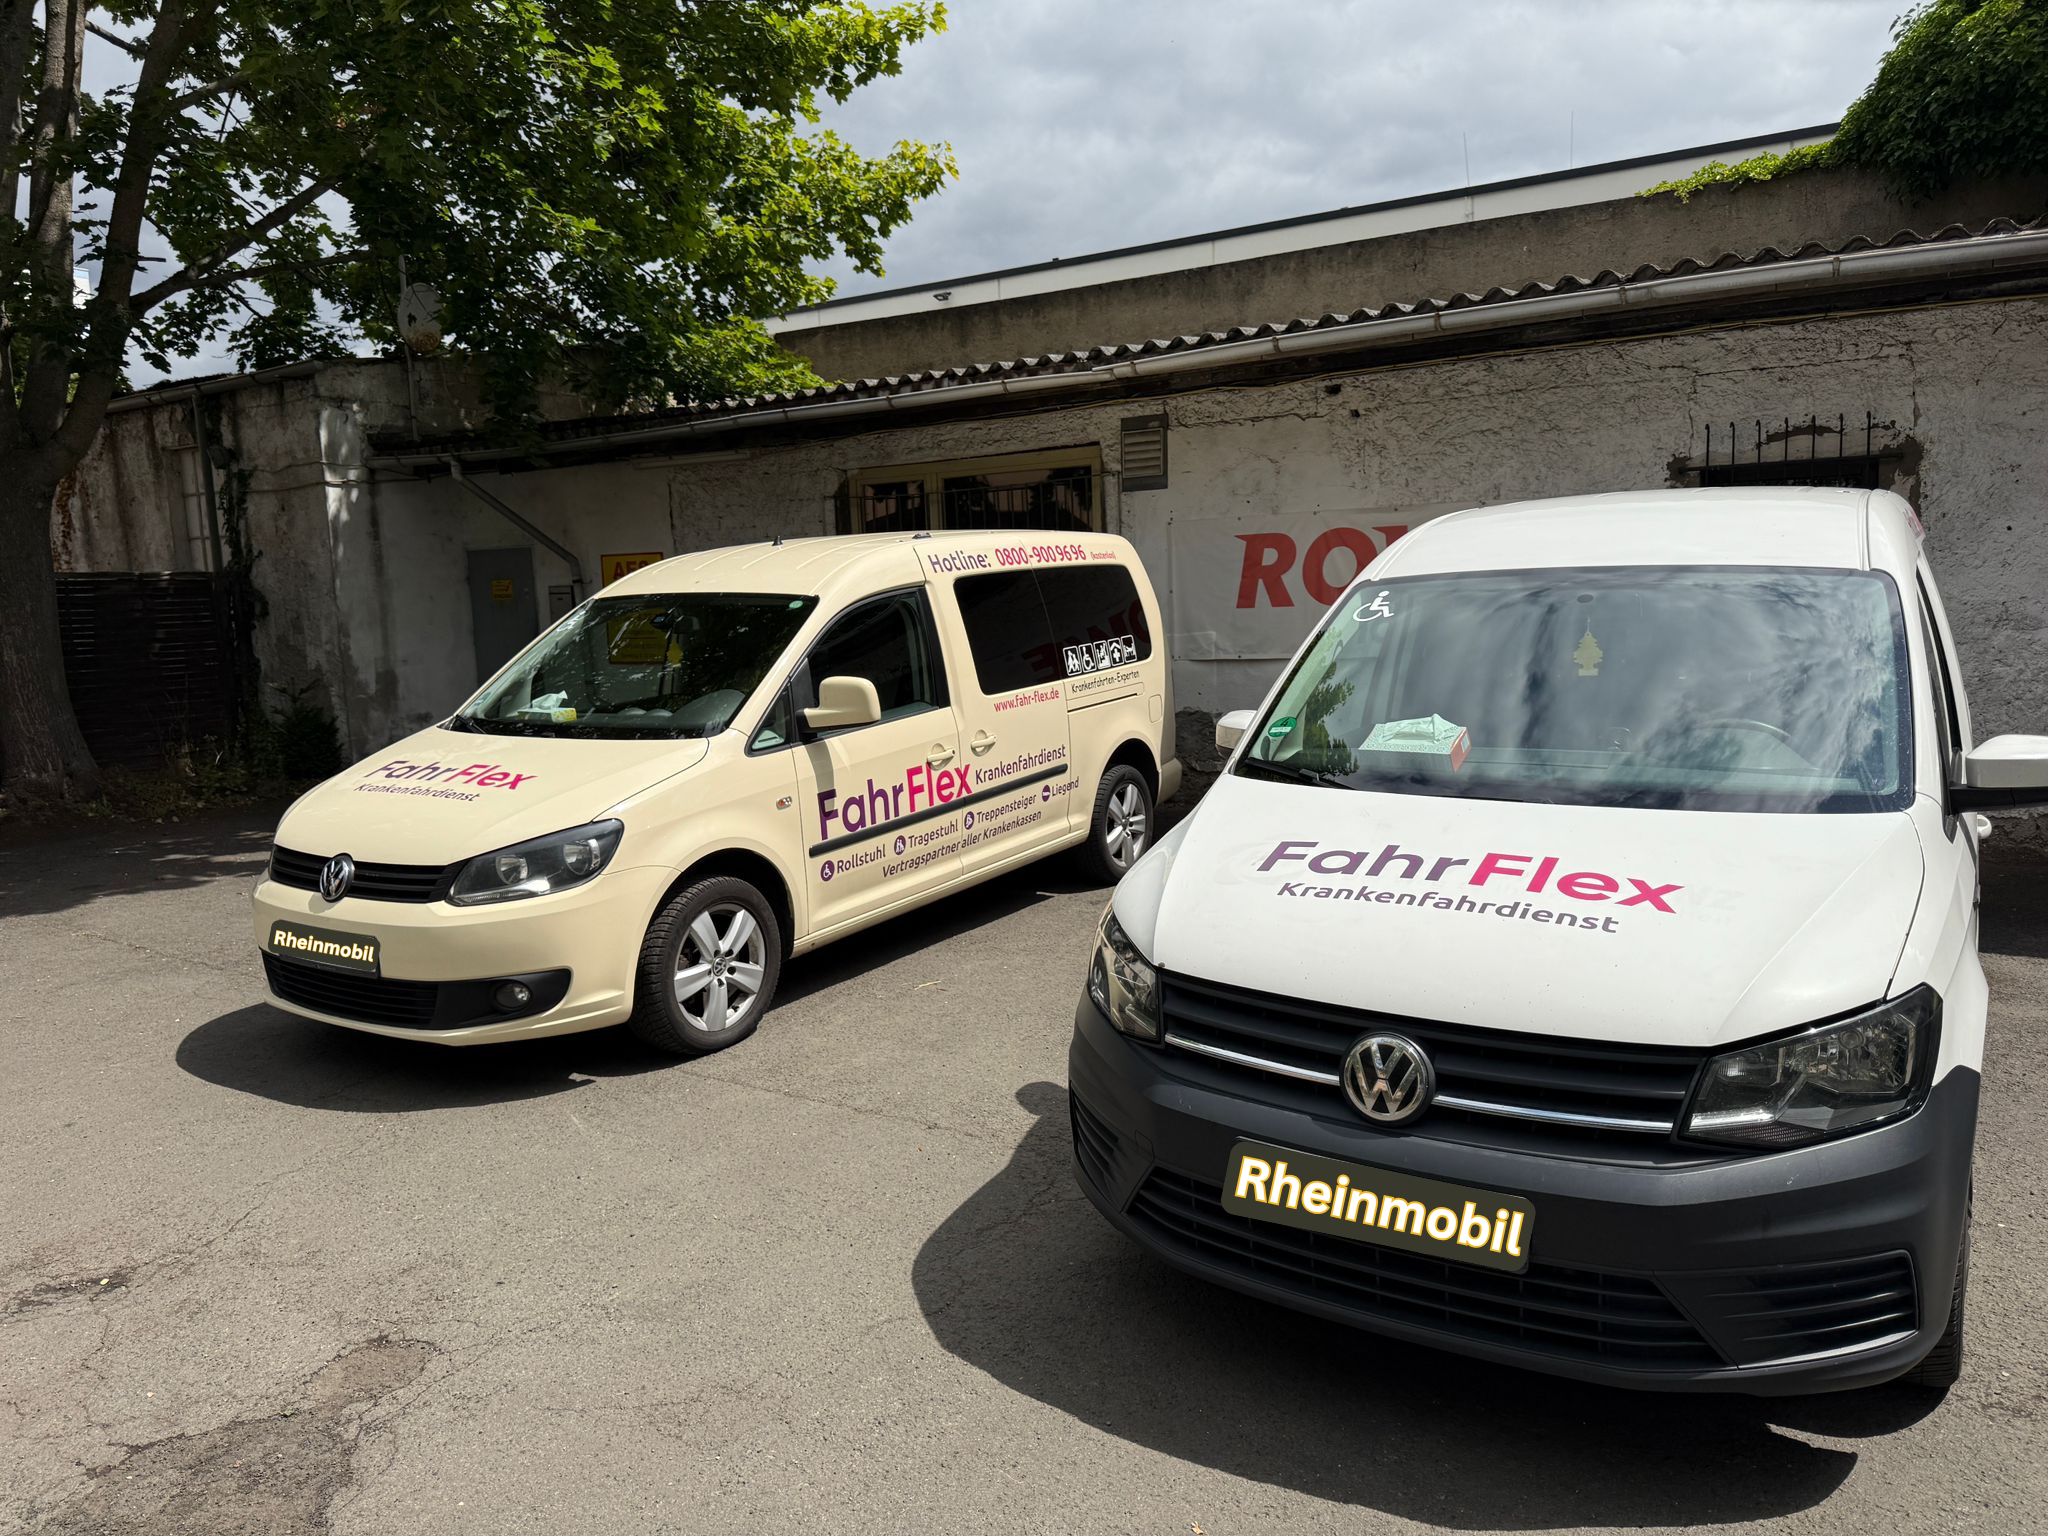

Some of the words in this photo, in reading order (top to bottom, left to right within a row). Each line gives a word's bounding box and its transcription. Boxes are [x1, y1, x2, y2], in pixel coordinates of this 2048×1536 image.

[928, 550, 992, 573] Hotline:
[994, 544, 1087, 566] 0800-9009696
[994, 688, 1060, 712] www.fahr-flex.de
[1071, 670, 1139, 692] Krankenfahrten-Experten
[354, 783, 480, 801] Krankenfahrdienst
[364, 761, 539, 790] FahrFlex
[817, 762, 973, 841] FahrFlex
[975, 744, 1066, 784] Krankenfahrdienst
[837, 844, 886, 873] Rollstuhl
[908, 819, 958, 848] Tragestuhl
[977, 794, 1036, 823] Treppensteiger
[1052, 776, 1079, 796] Liegend
[883, 841, 961, 877] Vertragspartner
[961, 832, 982, 848] aller
[983, 811, 1041, 840] Krankenkassen
[1256, 841, 1685, 914] FahrFlex
[1277, 882, 1620, 933] Krankenfahrdienst
